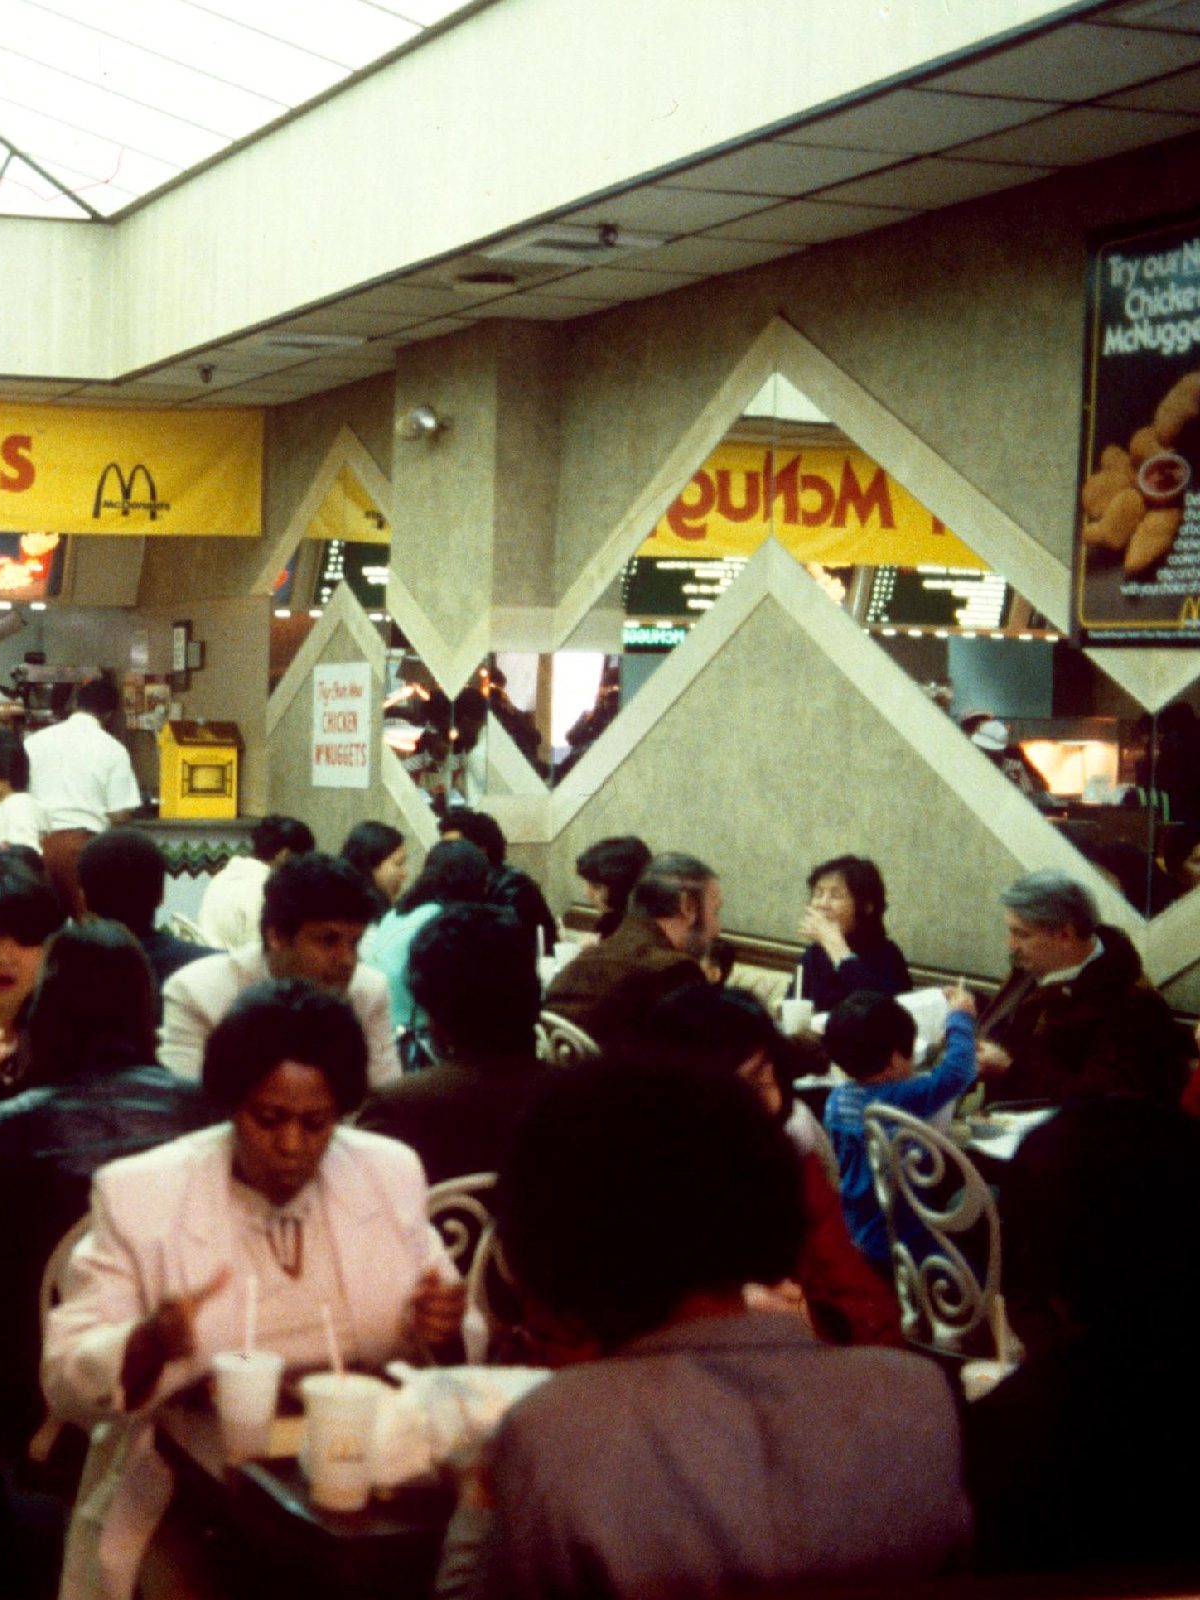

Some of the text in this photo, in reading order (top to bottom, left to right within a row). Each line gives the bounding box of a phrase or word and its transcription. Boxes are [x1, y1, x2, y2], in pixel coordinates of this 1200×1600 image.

[1108, 254, 1141, 291] Try
[1143, 250, 1179, 278] our
[1125, 282, 1200, 320] Chicke
[1102, 316, 1200, 356] McNugge
